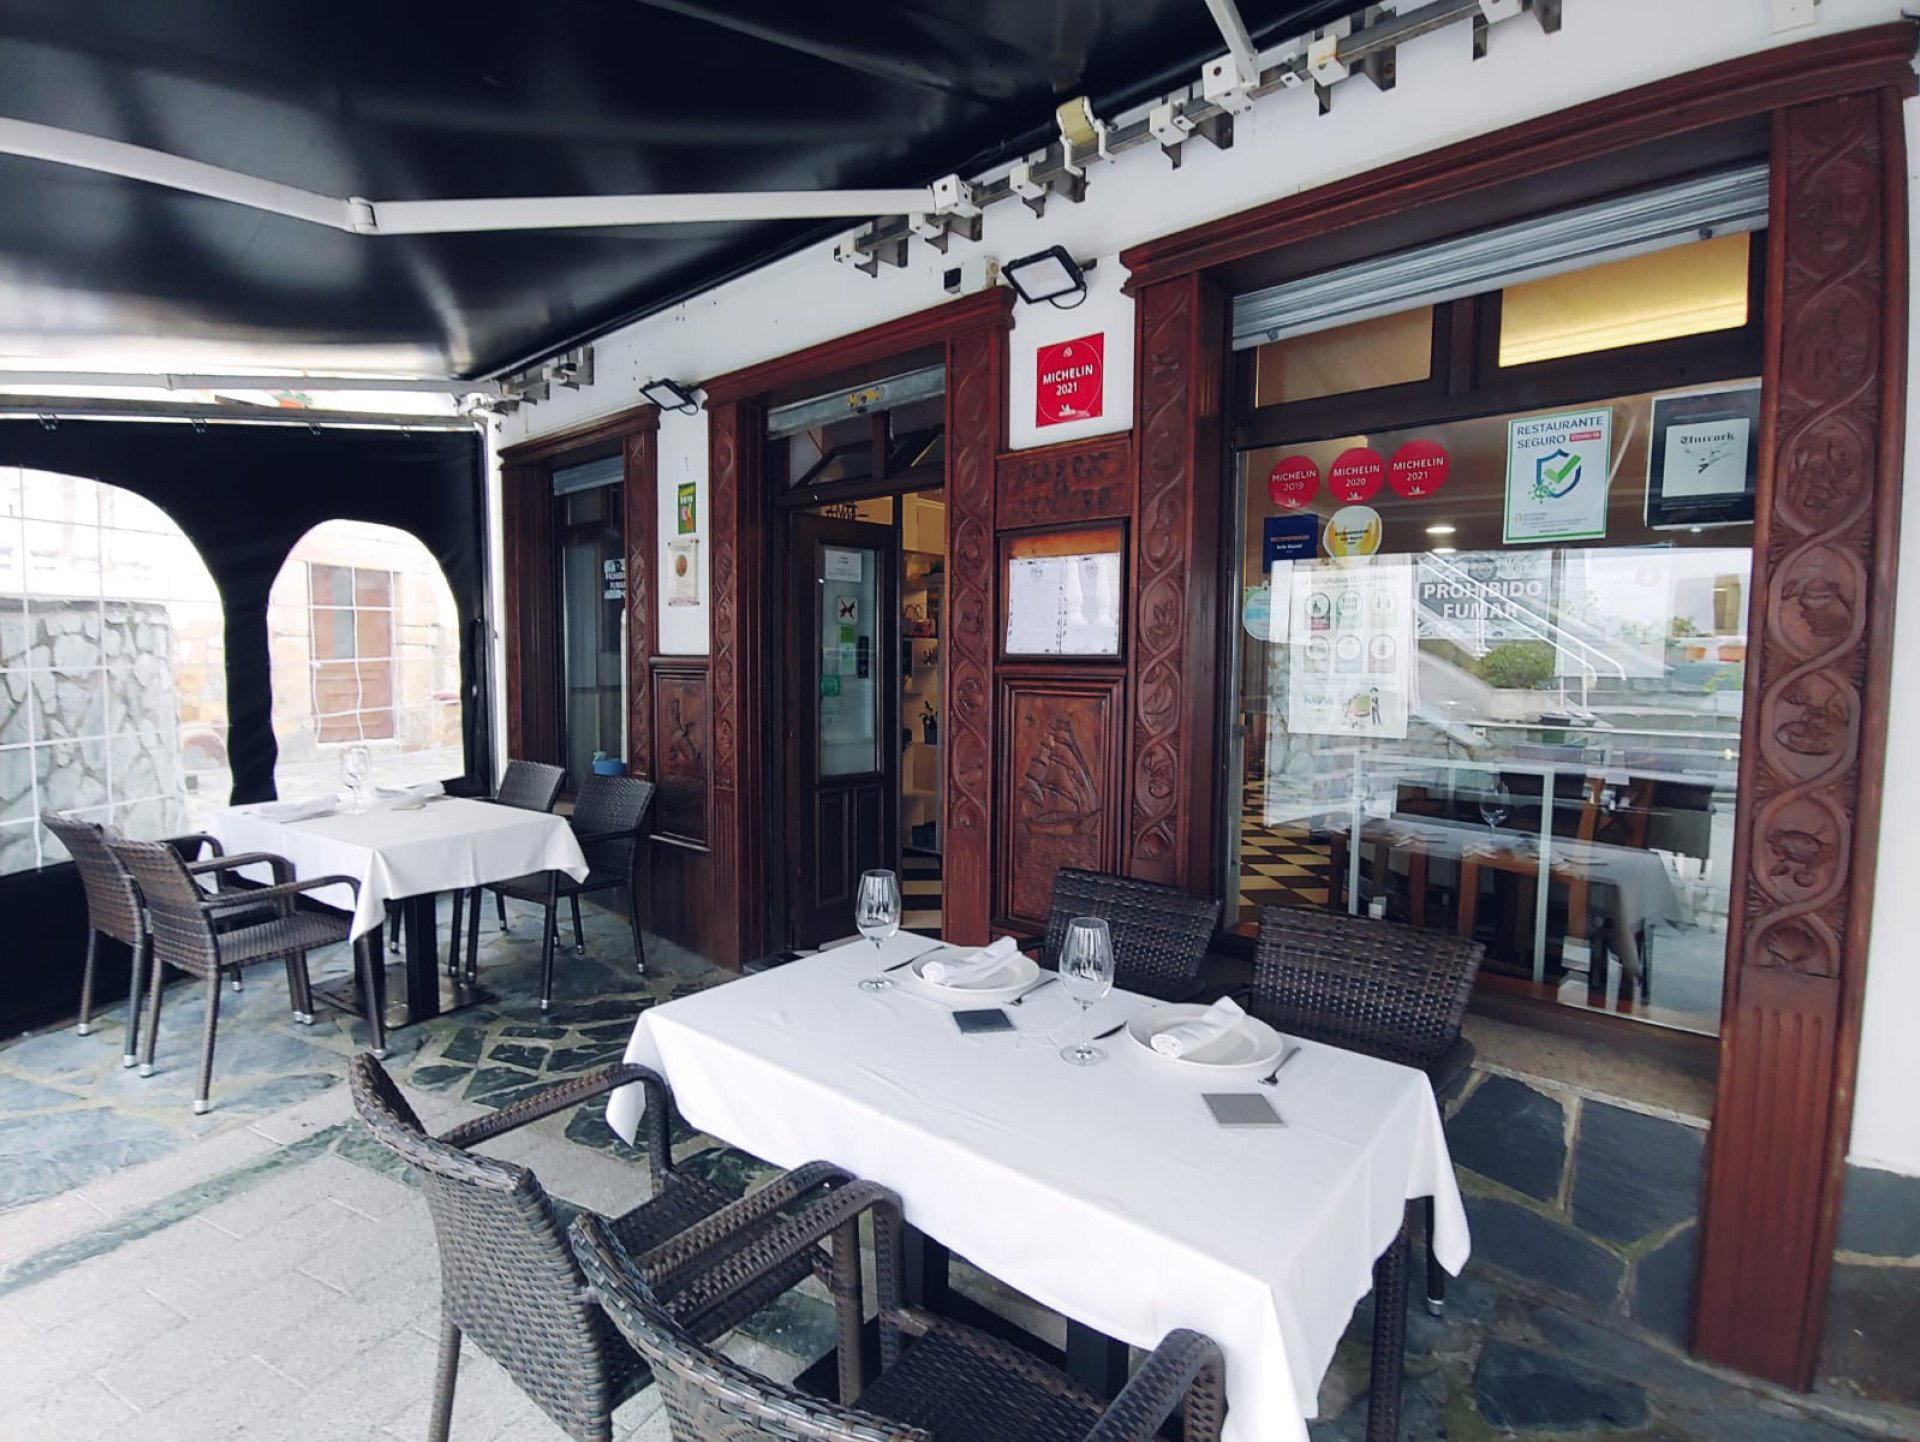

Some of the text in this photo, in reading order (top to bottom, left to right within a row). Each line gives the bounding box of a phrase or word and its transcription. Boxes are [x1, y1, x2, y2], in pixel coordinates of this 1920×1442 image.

[1042, 364, 1093, 386] MICHELIN
[1055, 381, 1078, 396] 2021
[1516, 416, 1604, 436] RESTAURANTE
[1517, 434, 1566, 449] SEGURO
[1332, 463, 1381, 478] MICHELIN
[1392, 456, 1445, 471] MICHELIN
[1271, 469, 1317, 482] MICHELIN
[1345, 477, 1367, 488] 2020
[1406, 471, 1429, 482] 2021
[1423, 580, 1543, 599] PROHIBIDO
[1442, 602, 1519, 620] FUMAR
